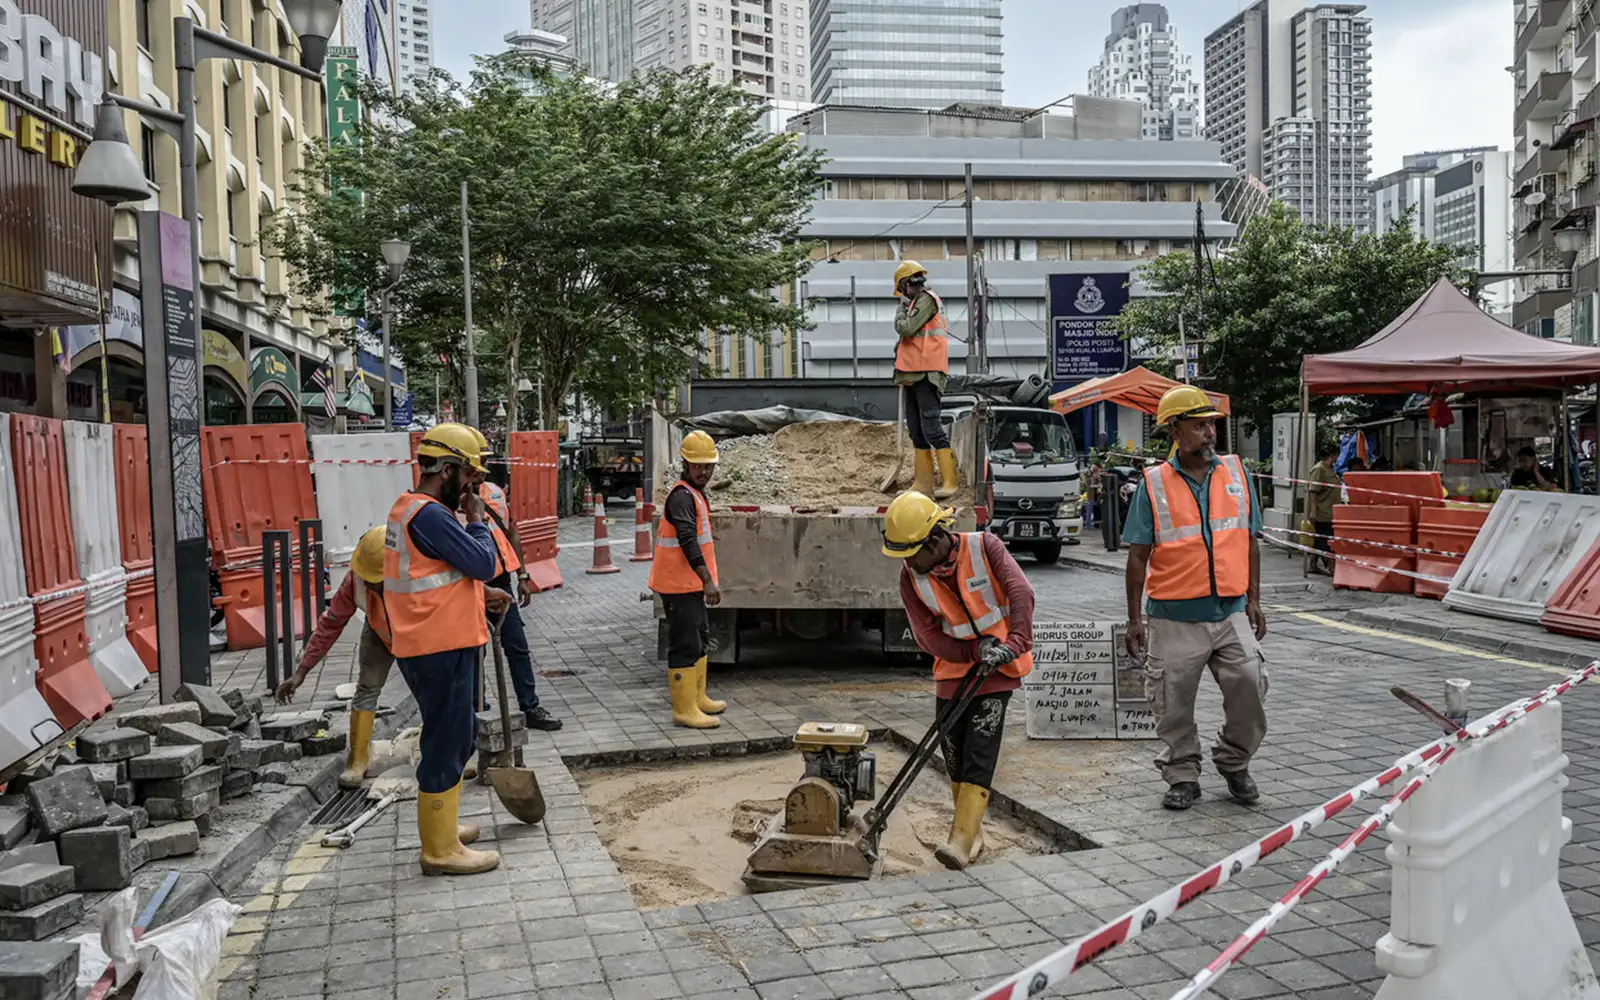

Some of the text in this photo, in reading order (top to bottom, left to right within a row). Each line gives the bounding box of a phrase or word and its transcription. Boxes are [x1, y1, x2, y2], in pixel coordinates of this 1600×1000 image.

[328, 47, 357, 56] HOTEL
[0, 101, 87, 169] LER
[1059, 321, 1094, 329] PONDOK
[1033, 630, 1104, 640] HIDRUS GROUP
[1060, 687, 1092, 698] JALAN
[1036, 700, 1100, 710] MASJID INDIA
